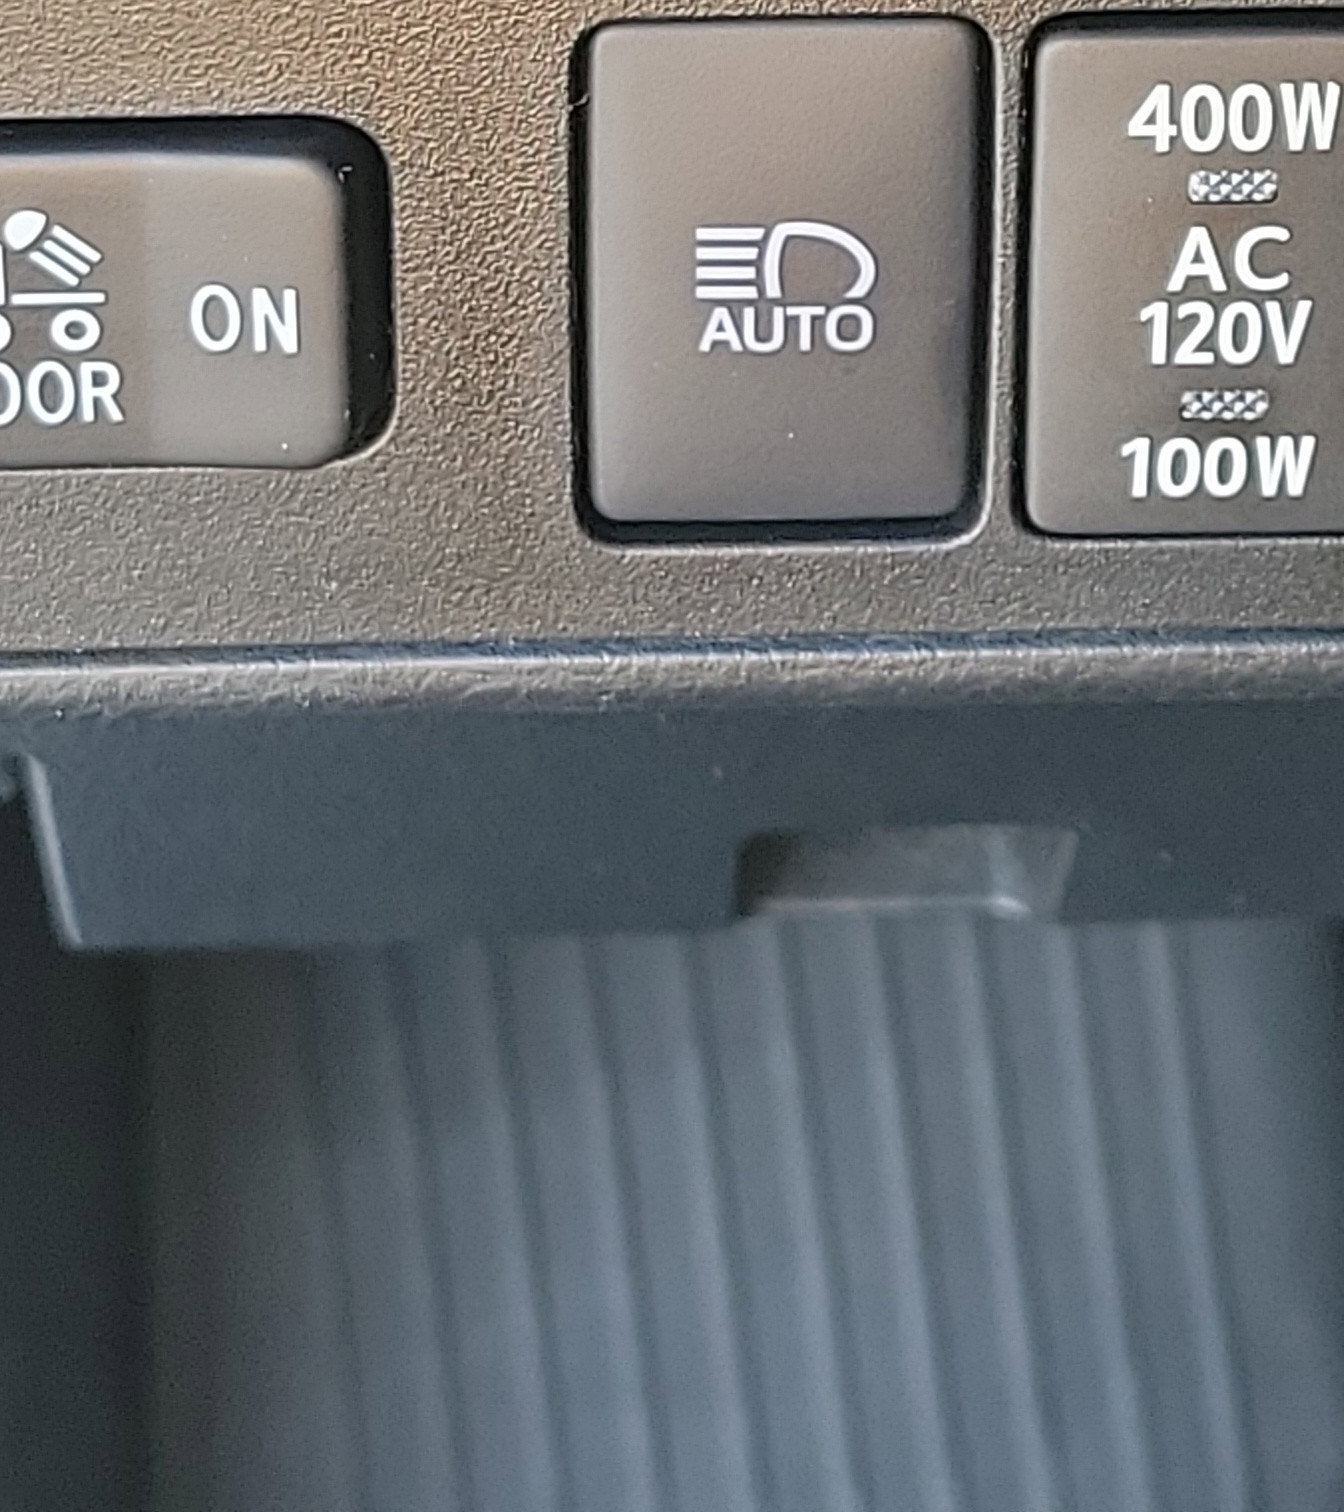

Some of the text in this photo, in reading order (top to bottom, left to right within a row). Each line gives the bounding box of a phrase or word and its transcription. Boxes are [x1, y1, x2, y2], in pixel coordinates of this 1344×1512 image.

[1126, 80, 1342, 154] 400W
[1165, 224, 1292, 293] AC
[189, 283, 300, 355] ON
[697, 303, 875, 354] AUTO
[1138, 298, 1315, 366] 120V
[1119, 434, 1318, 499] 100W
